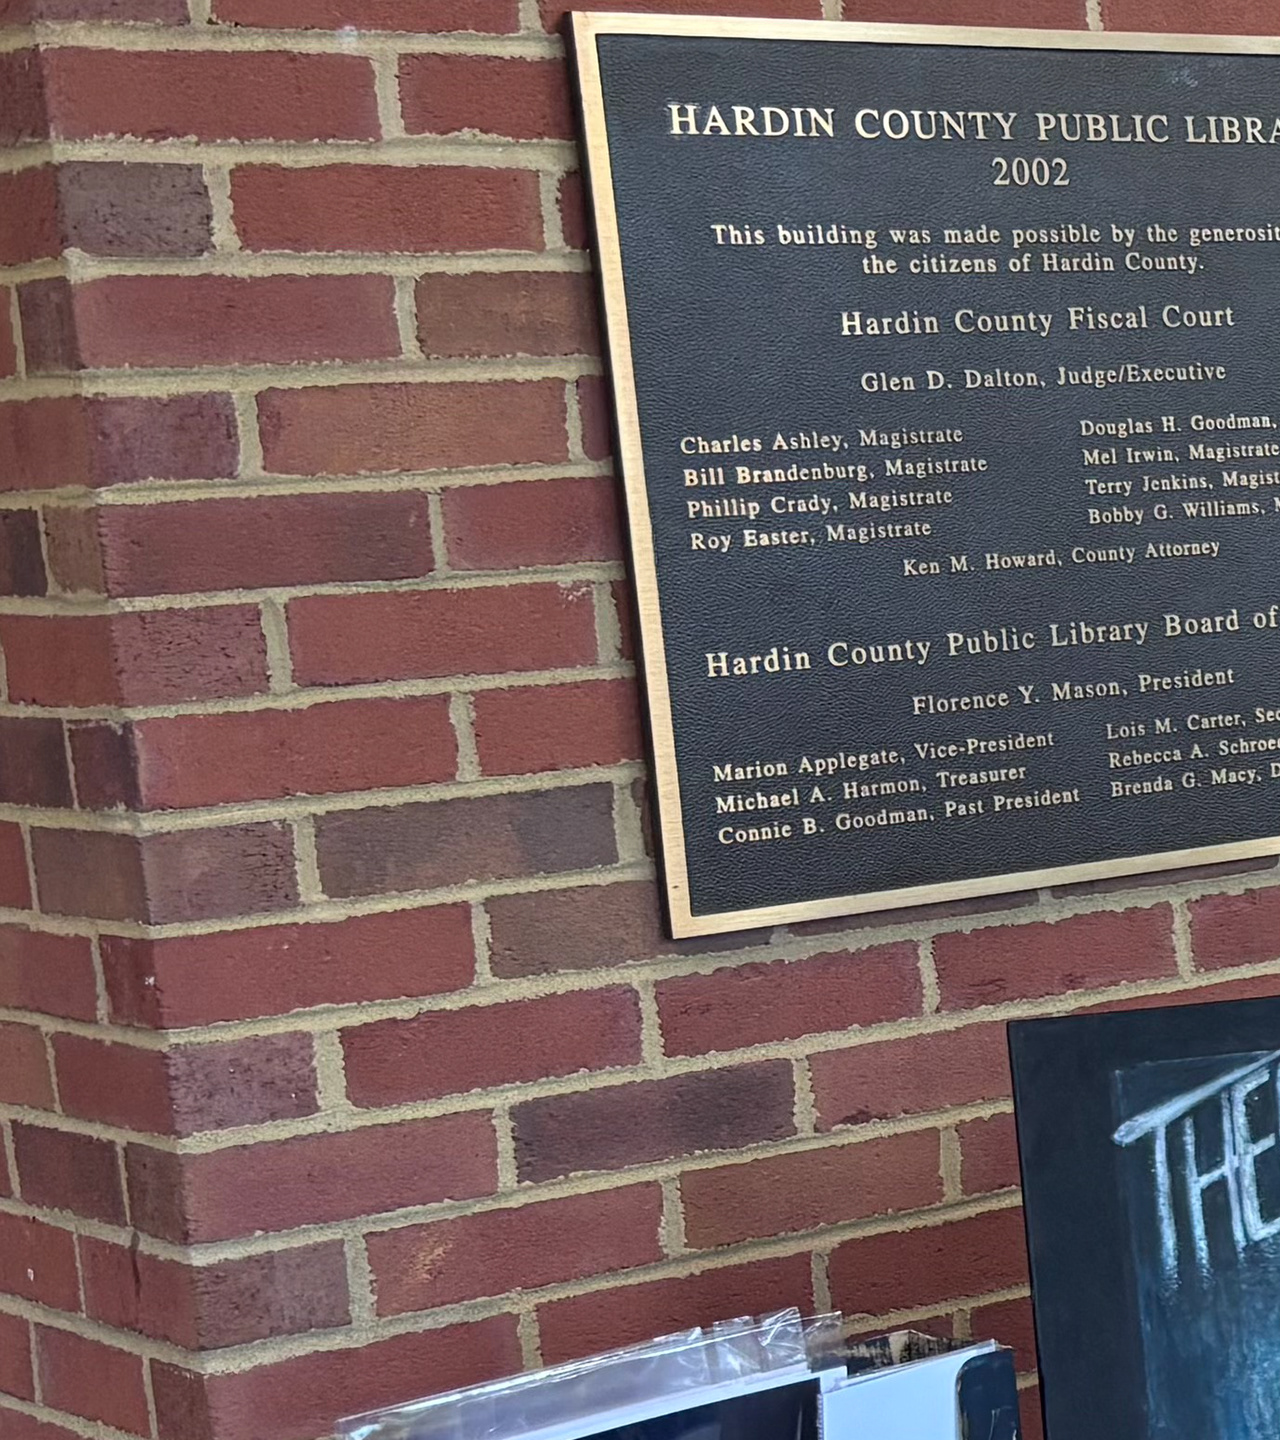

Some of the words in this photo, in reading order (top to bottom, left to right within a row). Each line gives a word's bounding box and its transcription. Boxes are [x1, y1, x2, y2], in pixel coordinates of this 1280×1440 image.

[669, 105, 834, 138] HARDIN
[855, 109, 1018, 143] COUNTY
[1037, 113, 1168, 144] PUBLIC
[992, 158, 1070, 187] 2002
[711, 224, 765, 246] This
[778, 223, 877, 249] building
[890, 226, 931, 246] was
[944, 224, 999, 245] made
[1012, 224, 1101, 248] possible
[1111, 223, 1136, 248] by
[1146, 223, 1178, 243] the
[862, 254, 898, 275] the
[909, 252, 997, 274] citizens
[1009, 252, 1030, 274] of
[1042, 251, 1114, 273] Hardin
[1125, 251, 1204, 276] County.
[841, 309, 940, 338] Hardin
[954, 309, 1053, 337] County
[1068, 305, 1147, 331] Fiscal
[1162, 304, 1235, 328] Court
[861, 369, 916, 393] Glen
[927, 368, 952, 391] D.
[964, 366, 1046, 390] Dalton,
[1057, 360, 1227, 388] Judge/Executive
[681, 436, 762, 454] Charles
[773, 432, 849, 452] Ashley,
[859, 427, 963, 447] Magistrate
[684, 468, 725, 486] Bill
[737, 463, 874, 485] Brandenburg,
[885, 456, 988, 476] Magistrate
[687, 499, 760, 519] Phillip
[771, 495, 839, 516] Crady,
[849, 489, 952, 510] Magistrate
[691, 531, 732, 551] Roy
[743, 528, 815, 548] Easter,
[826, 522, 932, 543] Magistrate
[903, 558, 940, 576] Ken
[950, 556, 974, 573] M.
[986, 550, 1062, 570] Howard,
[1072, 545, 1135, 564] County
[1145, 541, 1220, 559] Attorney
[706, 647, 811, 678] Hardin
[828, 639, 931, 667] County
[947, 627, 1035, 657] Public
[1050, 620, 1149, 648] Library
[1163, 610, 1239, 637] Board
[1254, 606, 1277, 628] of
[913, 691, 1009, 714] Florence
[1018, 685, 1040, 704] Y.
[1052, 679, 1128, 700] Mason,
[1139, 669, 1235, 693] President
[713, 763, 787, 782] Marion
[799, 749, 905, 777] Applegate,
[914, 732, 1054, 760] Vice-President
[716, 790, 800, 814] Michael
[810, 788, 831, 804] A.
[843, 779, 927, 801] Harmon,
[936, 765, 1026, 789] Treasurer
[718, 825, 792, 845] Connie
[803, 819, 824, 835] B.
[836, 808, 934, 831] Goodman,
[945, 801, 984, 818] Past
[994, 789, 1080, 812] President
